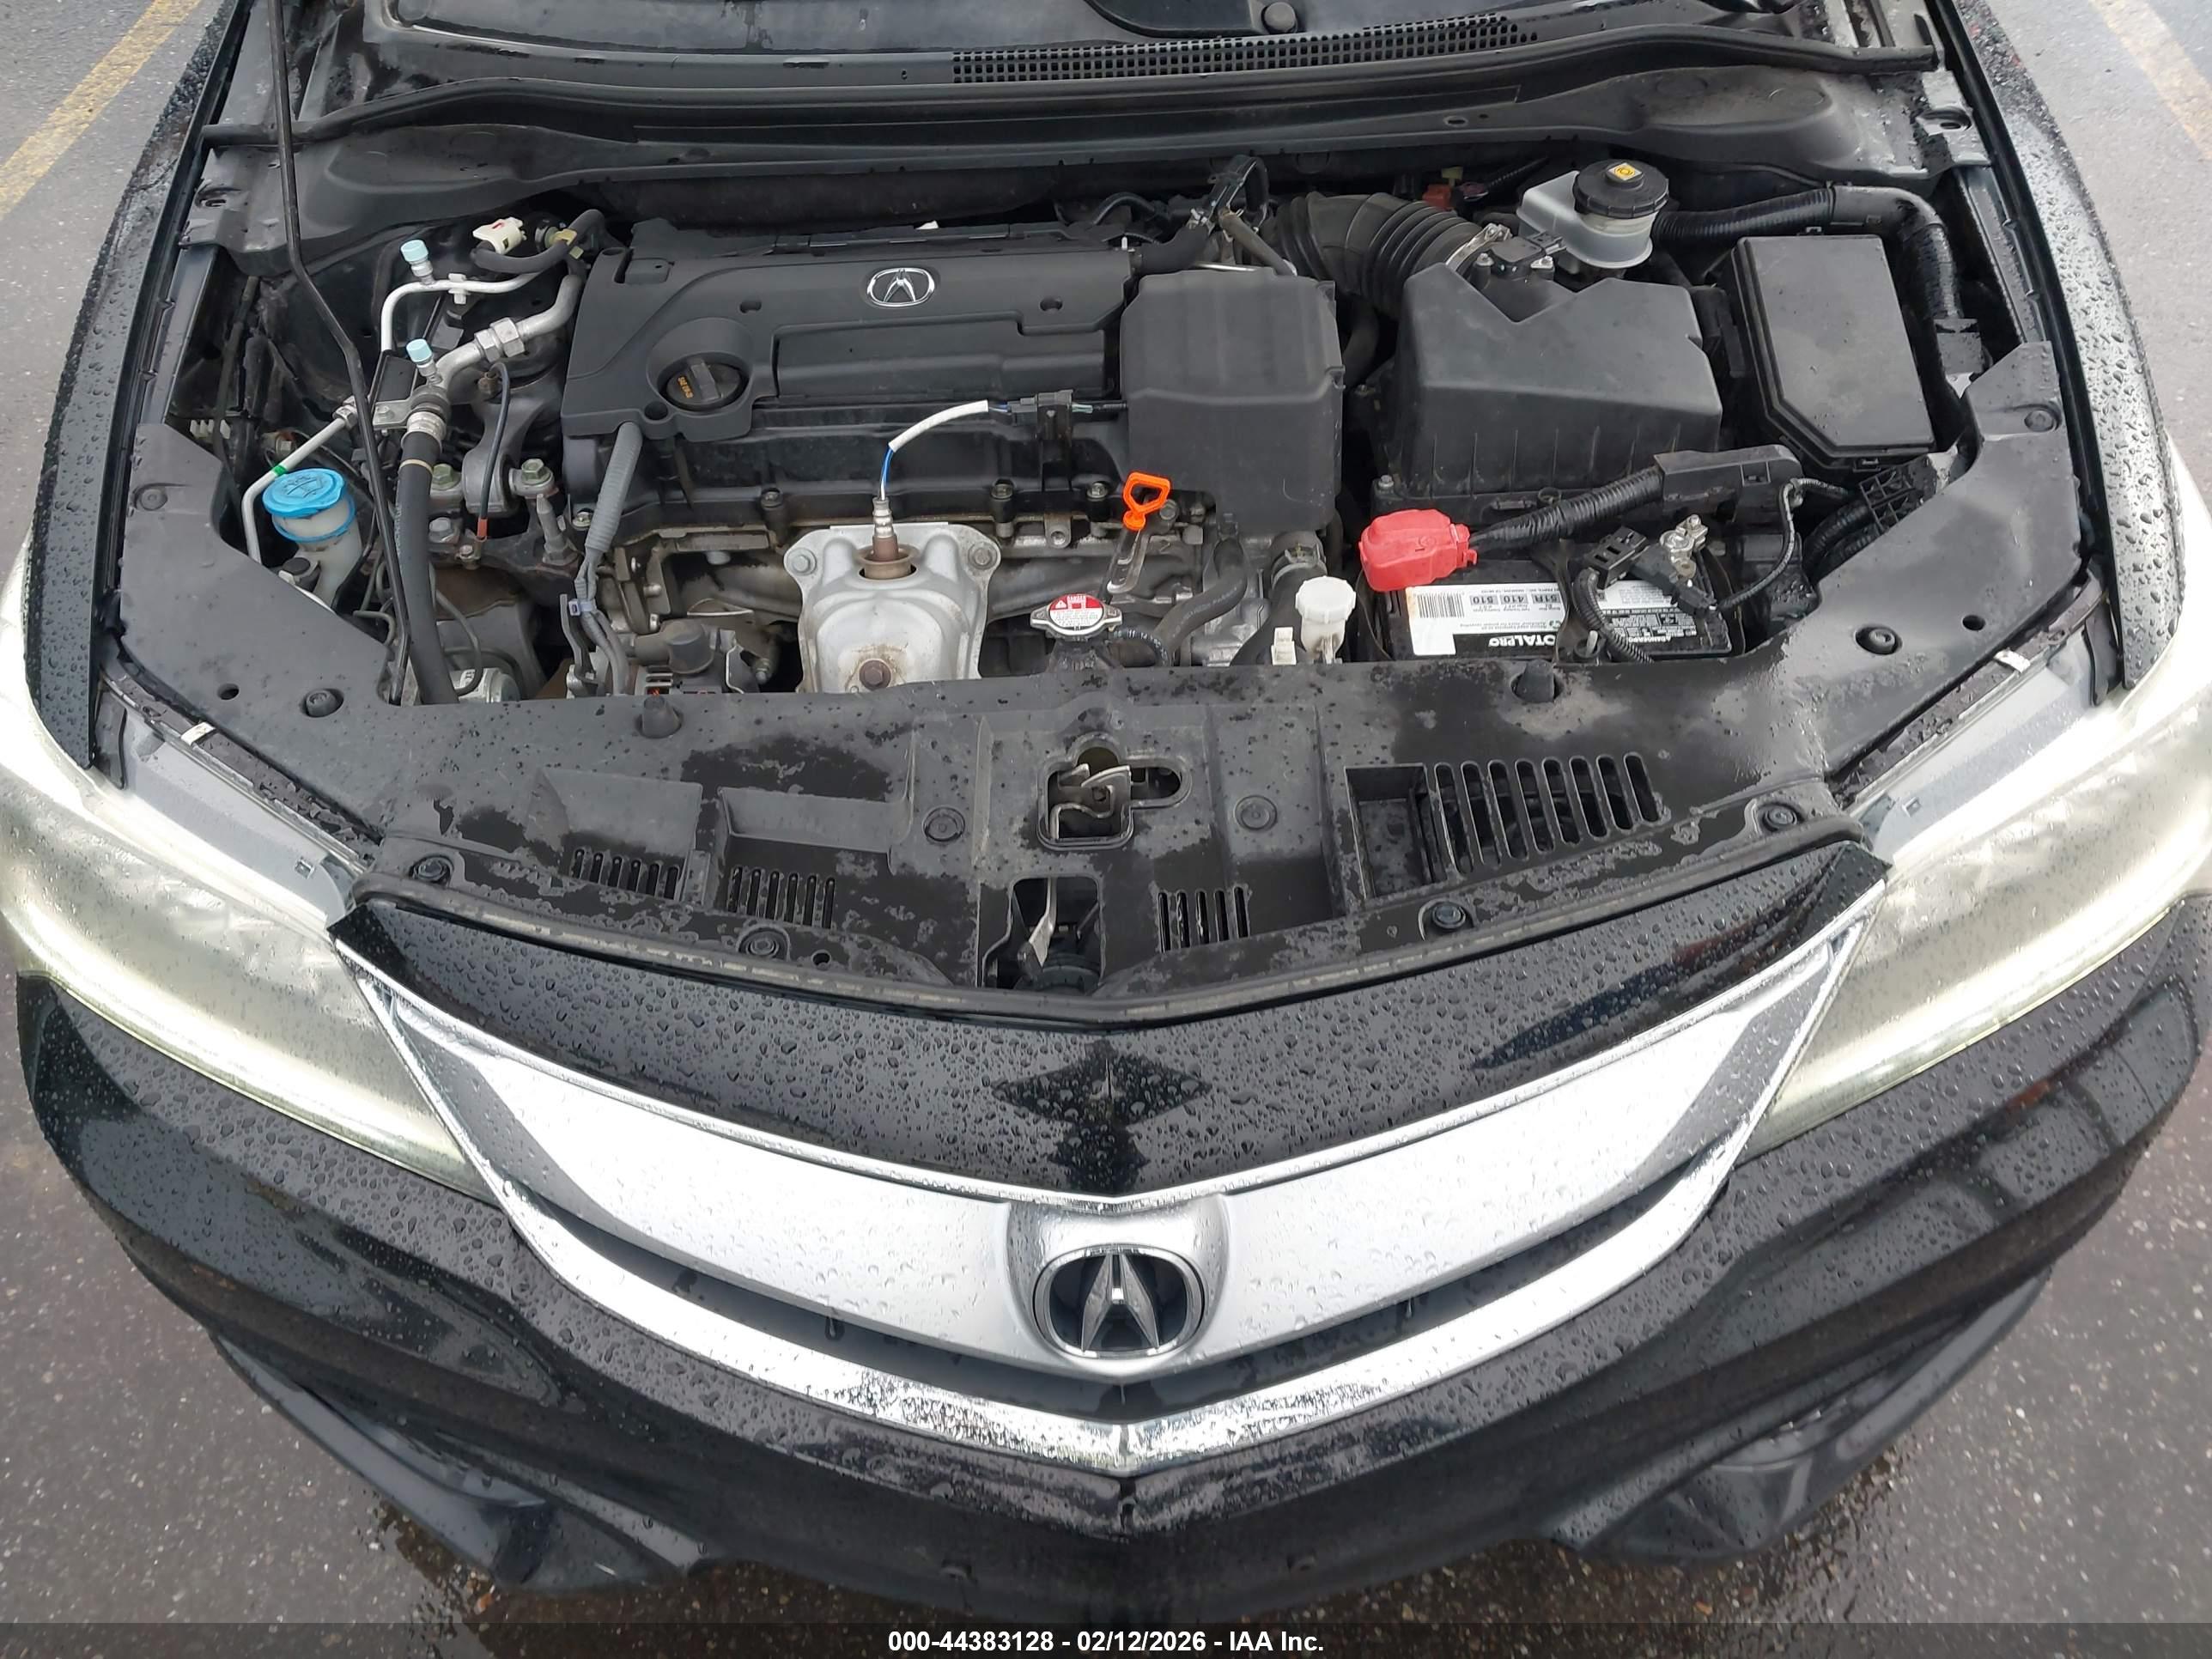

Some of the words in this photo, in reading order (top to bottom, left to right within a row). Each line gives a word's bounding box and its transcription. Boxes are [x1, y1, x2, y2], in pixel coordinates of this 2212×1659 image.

[1473, 596, 1493, 605] 510
[1503, 595, 1524, 604] 410
[1534, 594, 1558, 603] 51R
[1487, 634, 1556, 647] OTALPRO
